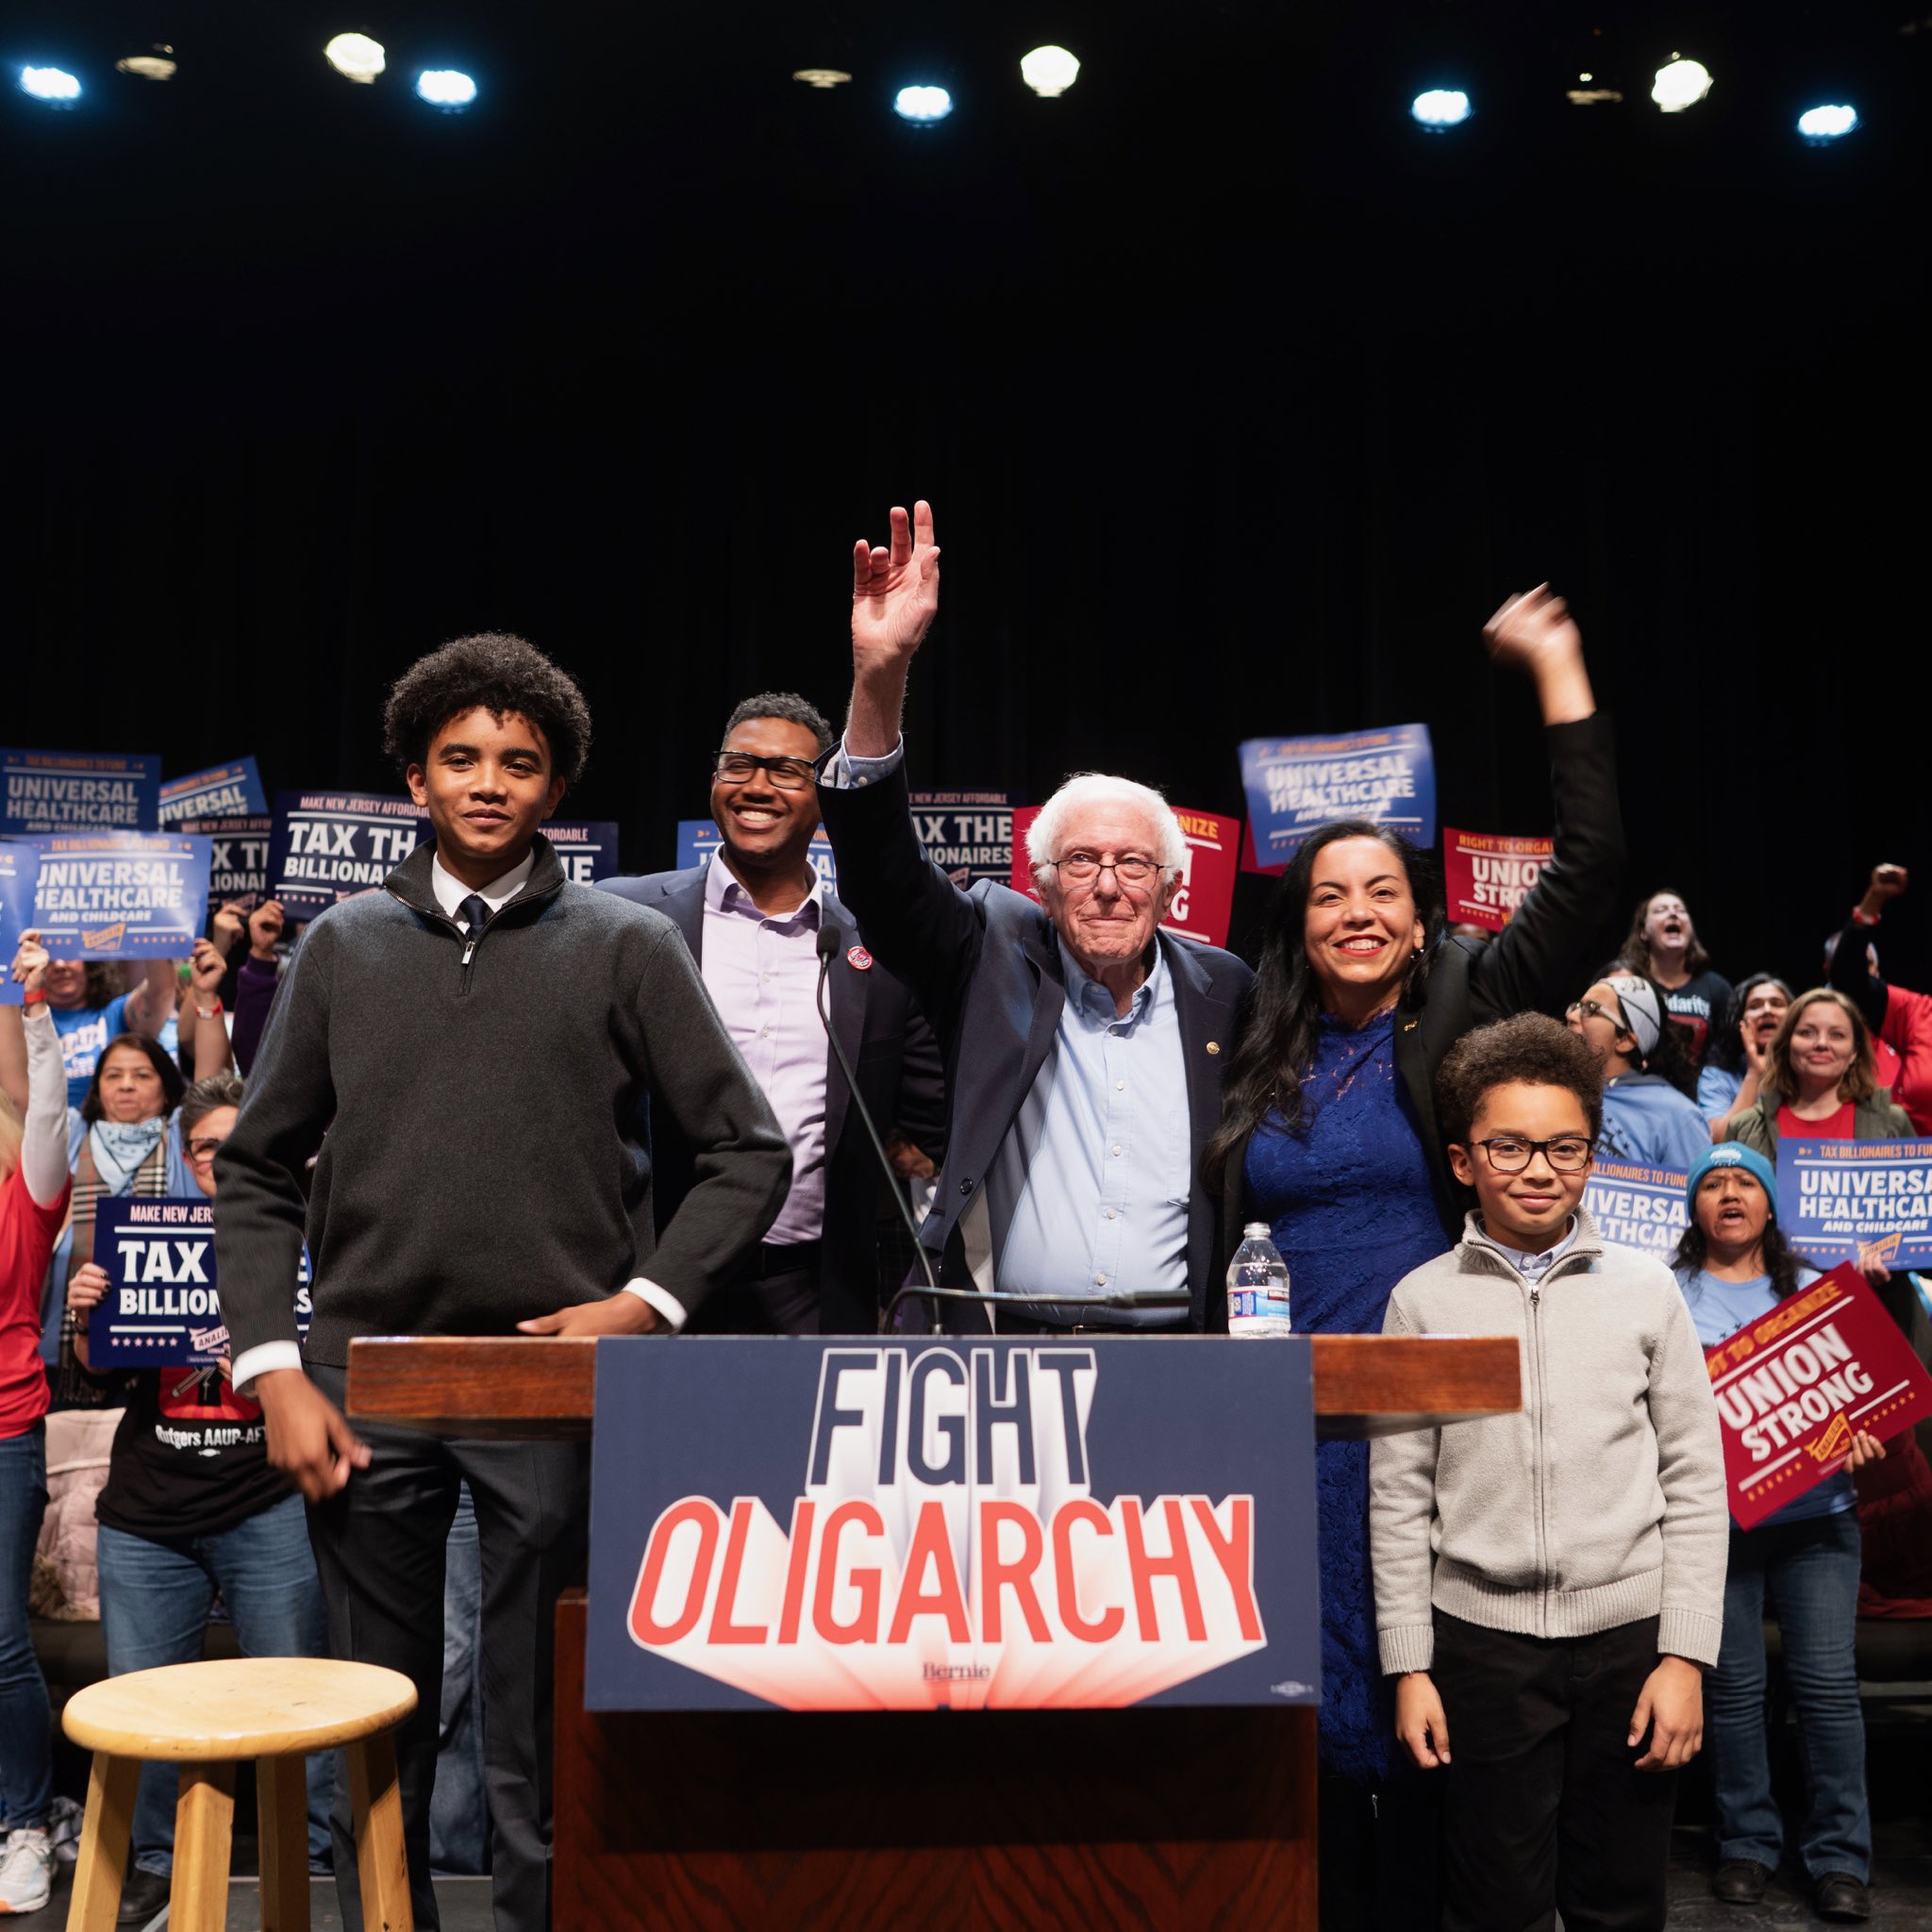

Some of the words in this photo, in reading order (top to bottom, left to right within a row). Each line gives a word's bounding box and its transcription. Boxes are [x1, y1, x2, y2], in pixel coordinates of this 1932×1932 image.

[1265, 755, 1413, 791] UNIVERSAL
[8, 776, 139, 803] UNIVERSAL
[1270, 778, 1415, 813] HEALTHCARE
[7, 799, 138, 824] HEALTHCARE
[300, 796, 324, 810] MAKE
[325, 798, 346, 811] NEW
[347, 799, 381, 814] JERSEY
[954, 816, 1012, 843] THE
[1178, 814, 1219, 839] NIZE
[288, 822, 358, 858] TAX
[368, 827, 417, 862] TH
[1458, 834, 1494, 850] RIGHT
[1497, 840, 1513, 854] TO
[1515, 841, 1555, 855] ORGA
[1472, 856, 1551, 887] UNIO
[1474, 881, 1530, 908] STRO
[49, 911, 79, 923] AND
[81, 910, 151, 923] CHILDCARE
[1820, 1144, 1838, 1158] TAX
[1840, 1144, 1902, 1158] BILLIONAIRES
[1904, 1143, 1915, 1158] TO
[1652, 1171, 1663, 1184] TO
[130, 1206, 161, 1223] MAKE
[163, 1206, 188, 1223] NEW
[1822, 1220, 1853, 1233] AND
[1856, 1219, 1928, 1233] CHILDCARE
[117, 1241, 209, 1284] TAX
[119, 1289, 221, 1315] BILLION
[1726, 1335, 1755, 1361] TO
[1715, 1322, 1854, 1431] UNION
[807, 1347, 1098, 1489] FIGHT
[1740, 1360, 1875, 1462] STRONG
[156, 1424, 202, 1450] Rutgers
[628, 1495, 1267, 1648] OLIGARCHY
[923, 1661, 991, 1679] Bernie
